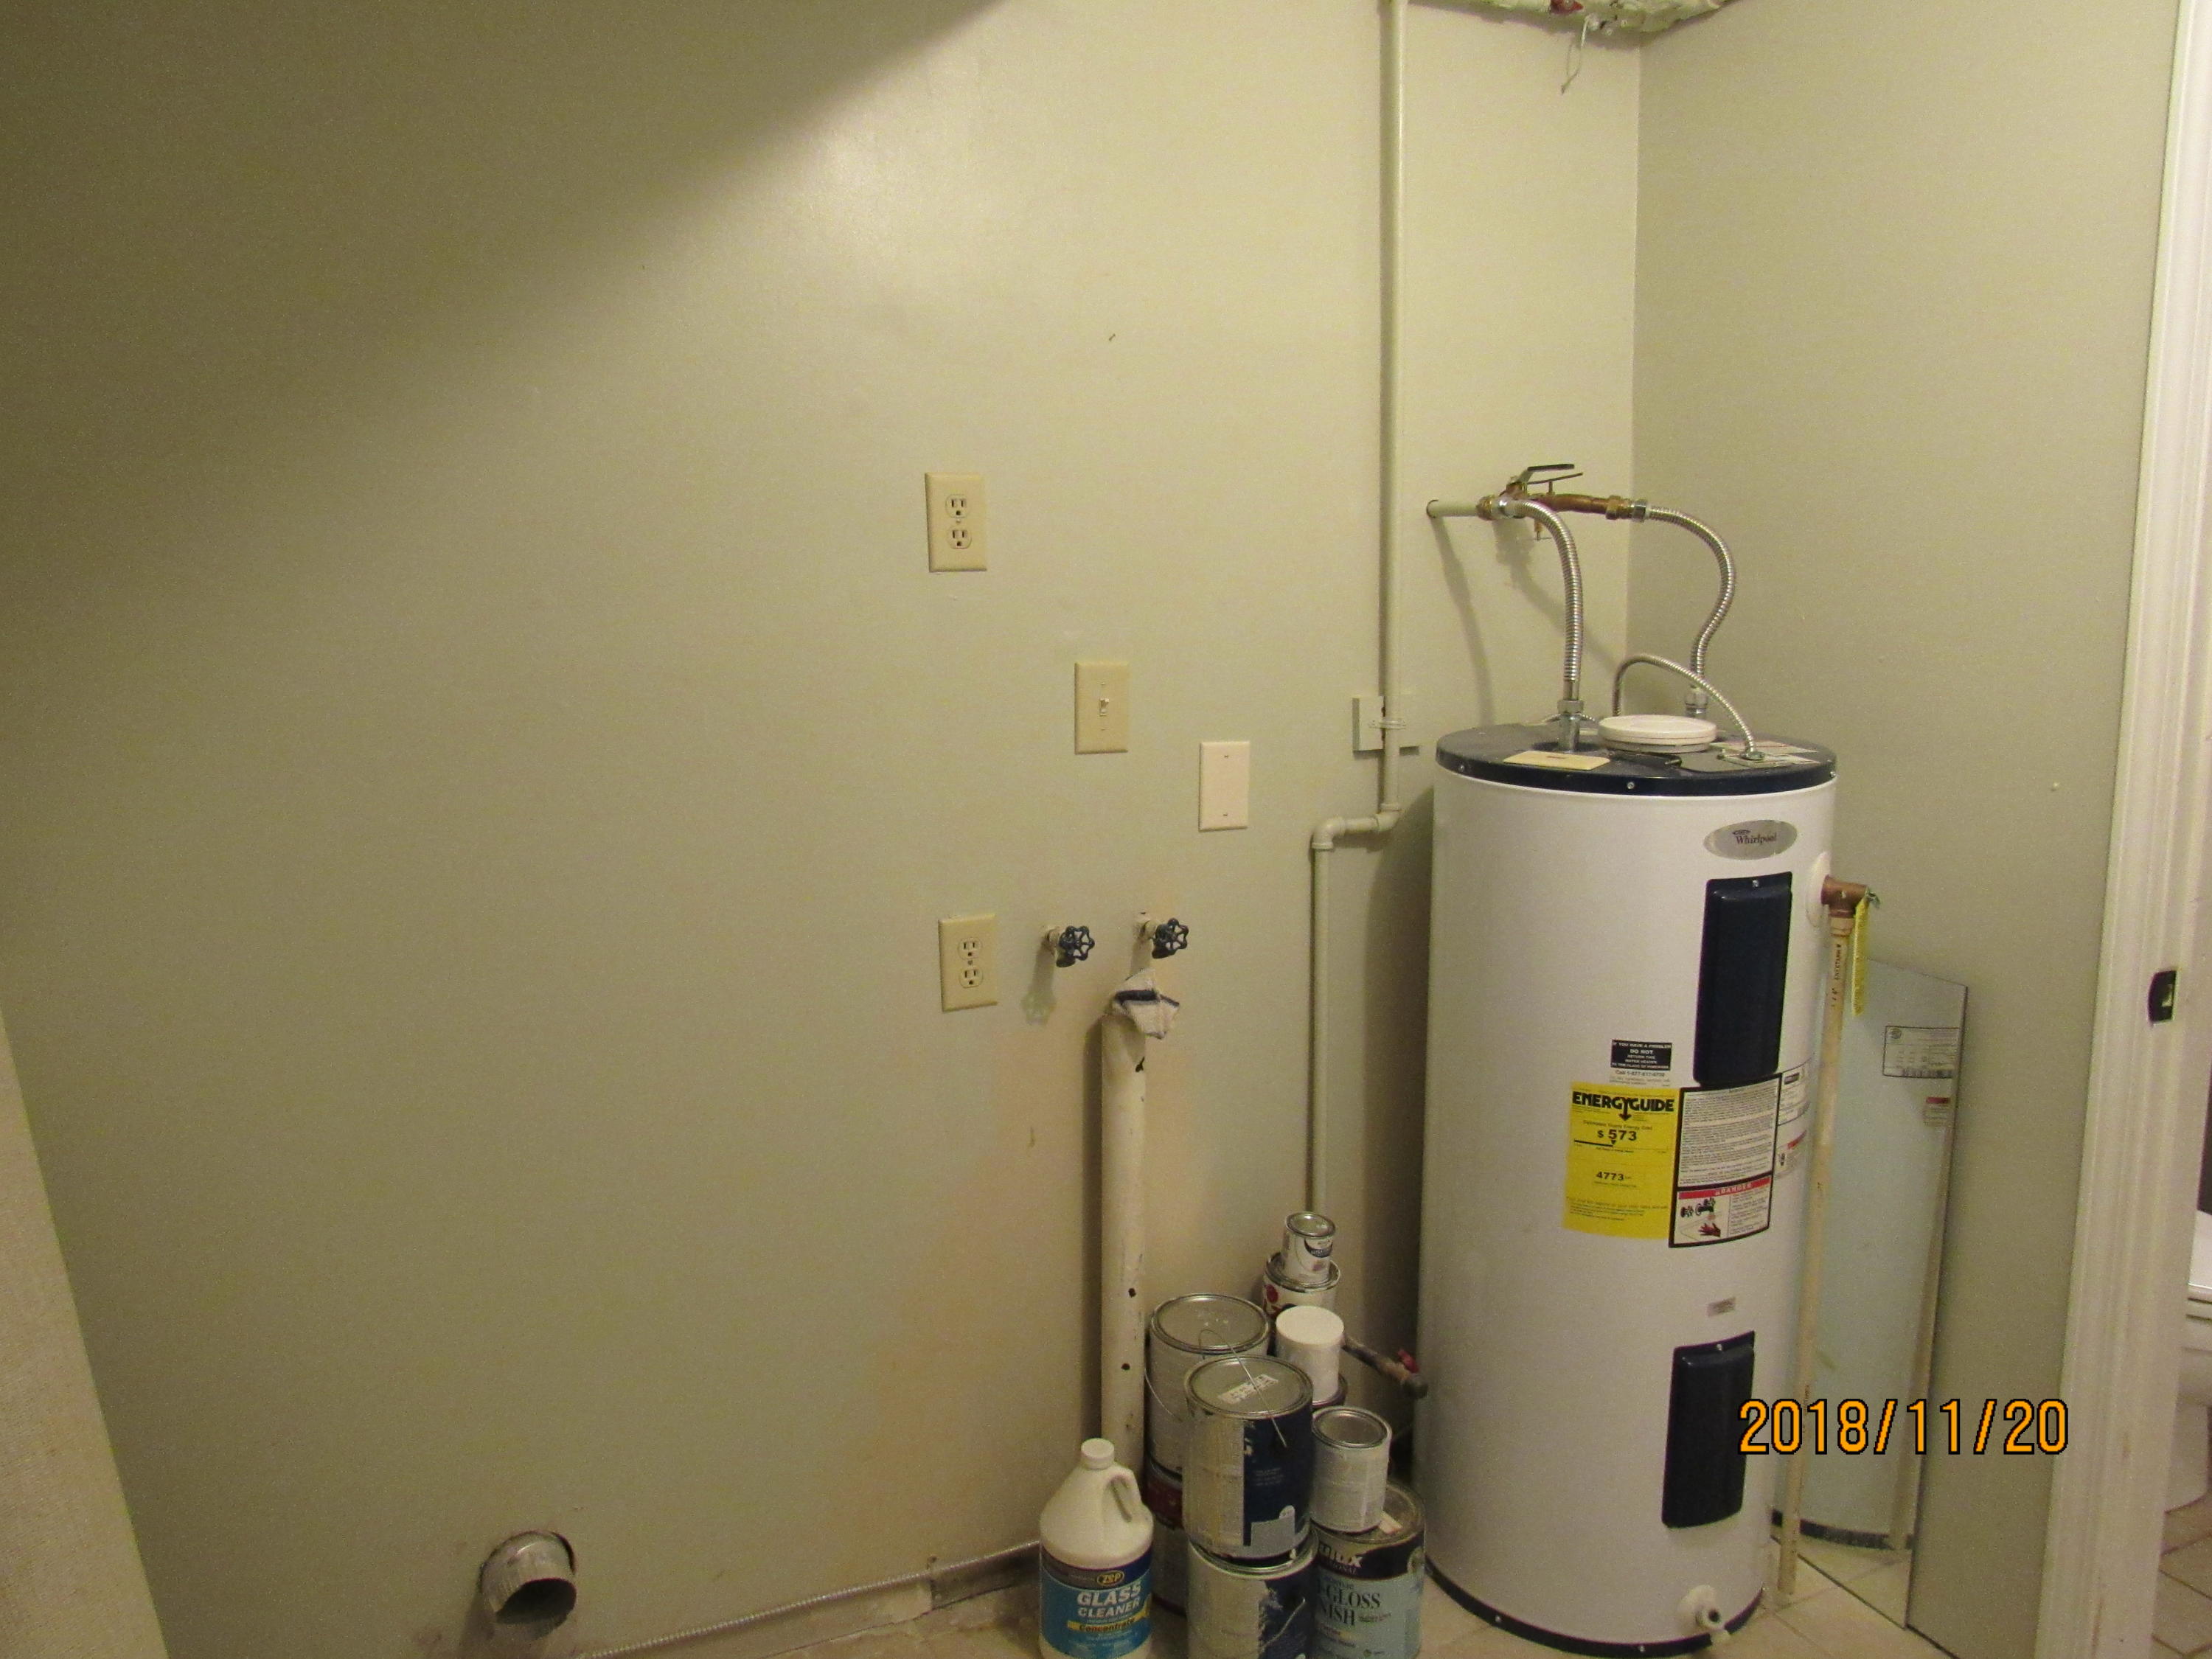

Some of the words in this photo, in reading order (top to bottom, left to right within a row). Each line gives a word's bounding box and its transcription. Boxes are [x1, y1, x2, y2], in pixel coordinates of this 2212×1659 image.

[1736, 832, 1777, 845] Whirlpool
[1572, 1091, 1674, 1112] ENERGYGUIDE
[1608, 1129, 1637, 1141] 573
[1596, 1171, 1624, 1181] 4773
[1077, 1579, 1141, 1607] GLASS
[1078, 1597, 1141, 1618] CLEANER
